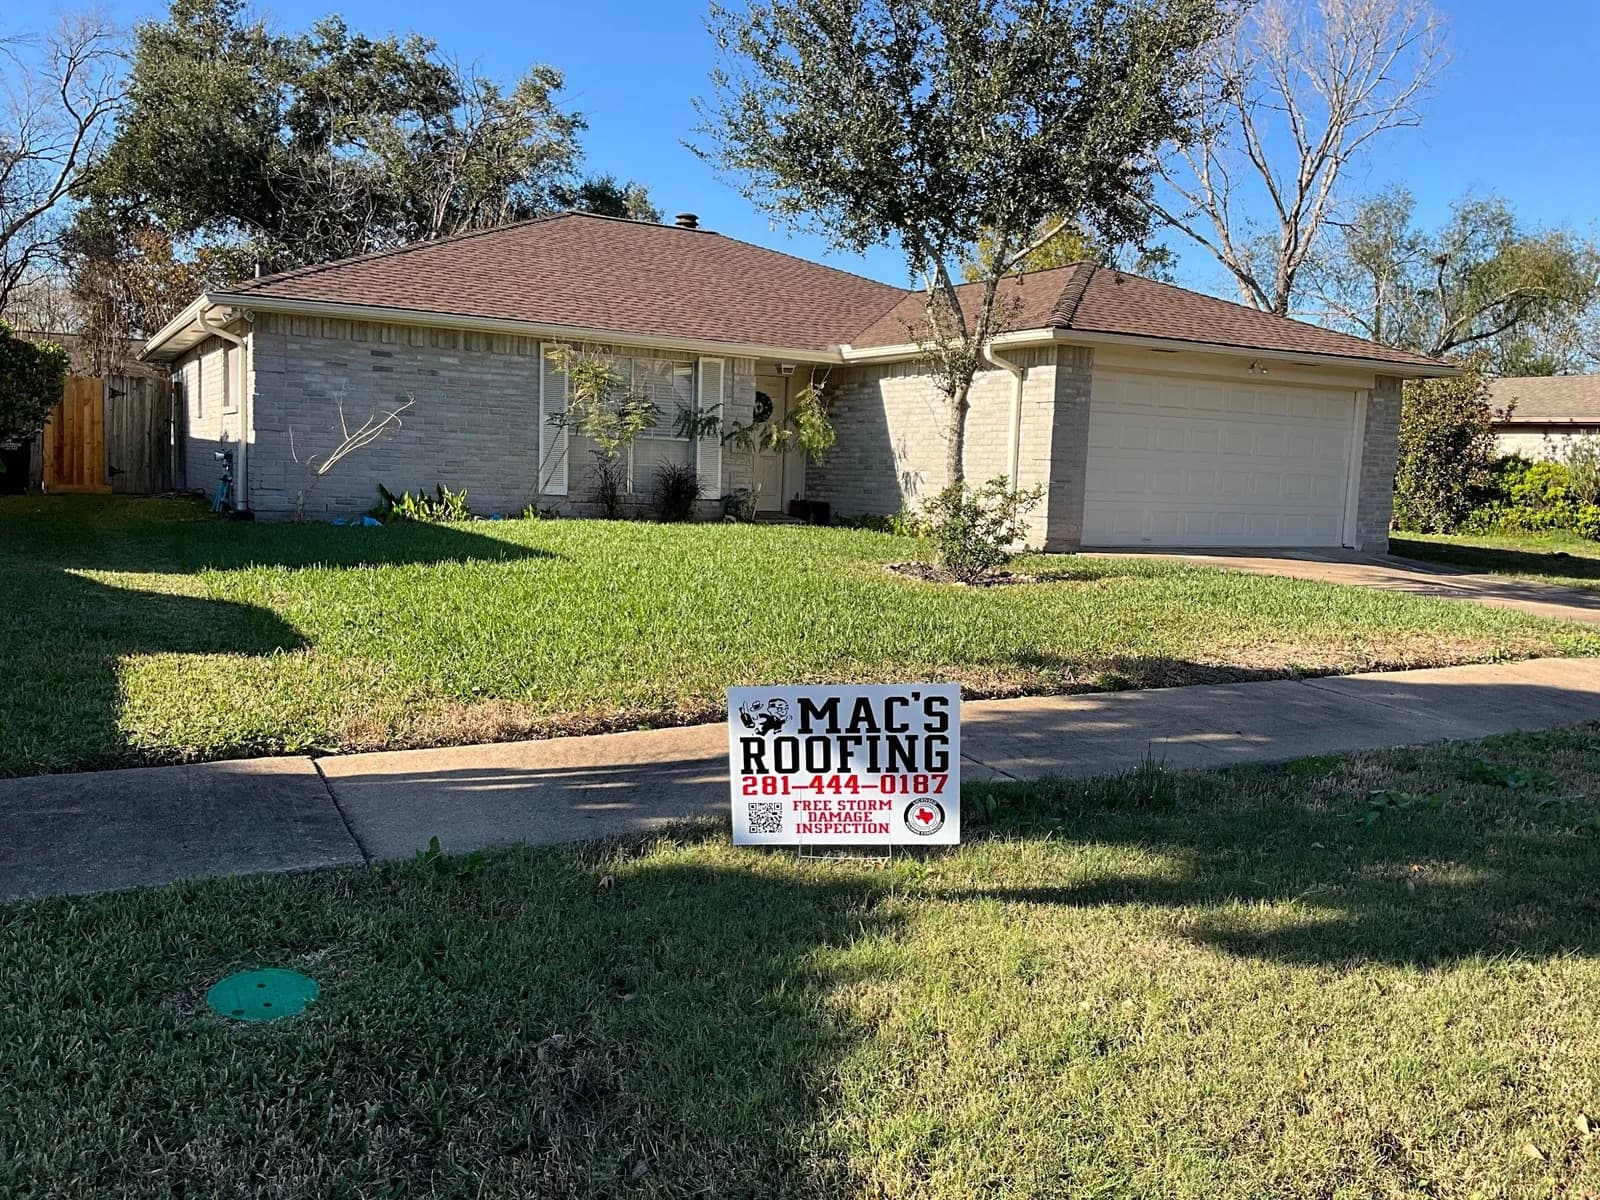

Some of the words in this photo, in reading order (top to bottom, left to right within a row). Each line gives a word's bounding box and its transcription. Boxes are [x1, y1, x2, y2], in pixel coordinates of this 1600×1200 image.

[797, 692, 949, 734] MAC'S
[740, 735, 949, 775] ROOFING
[742, 775, 949, 796] 281-444-0187
[793, 800, 832, 811] FREE
[838, 799, 893, 811] STORM
[808, 811, 873, 823] DAMAGE
[796, 823, 890, 834] INSPECTION
